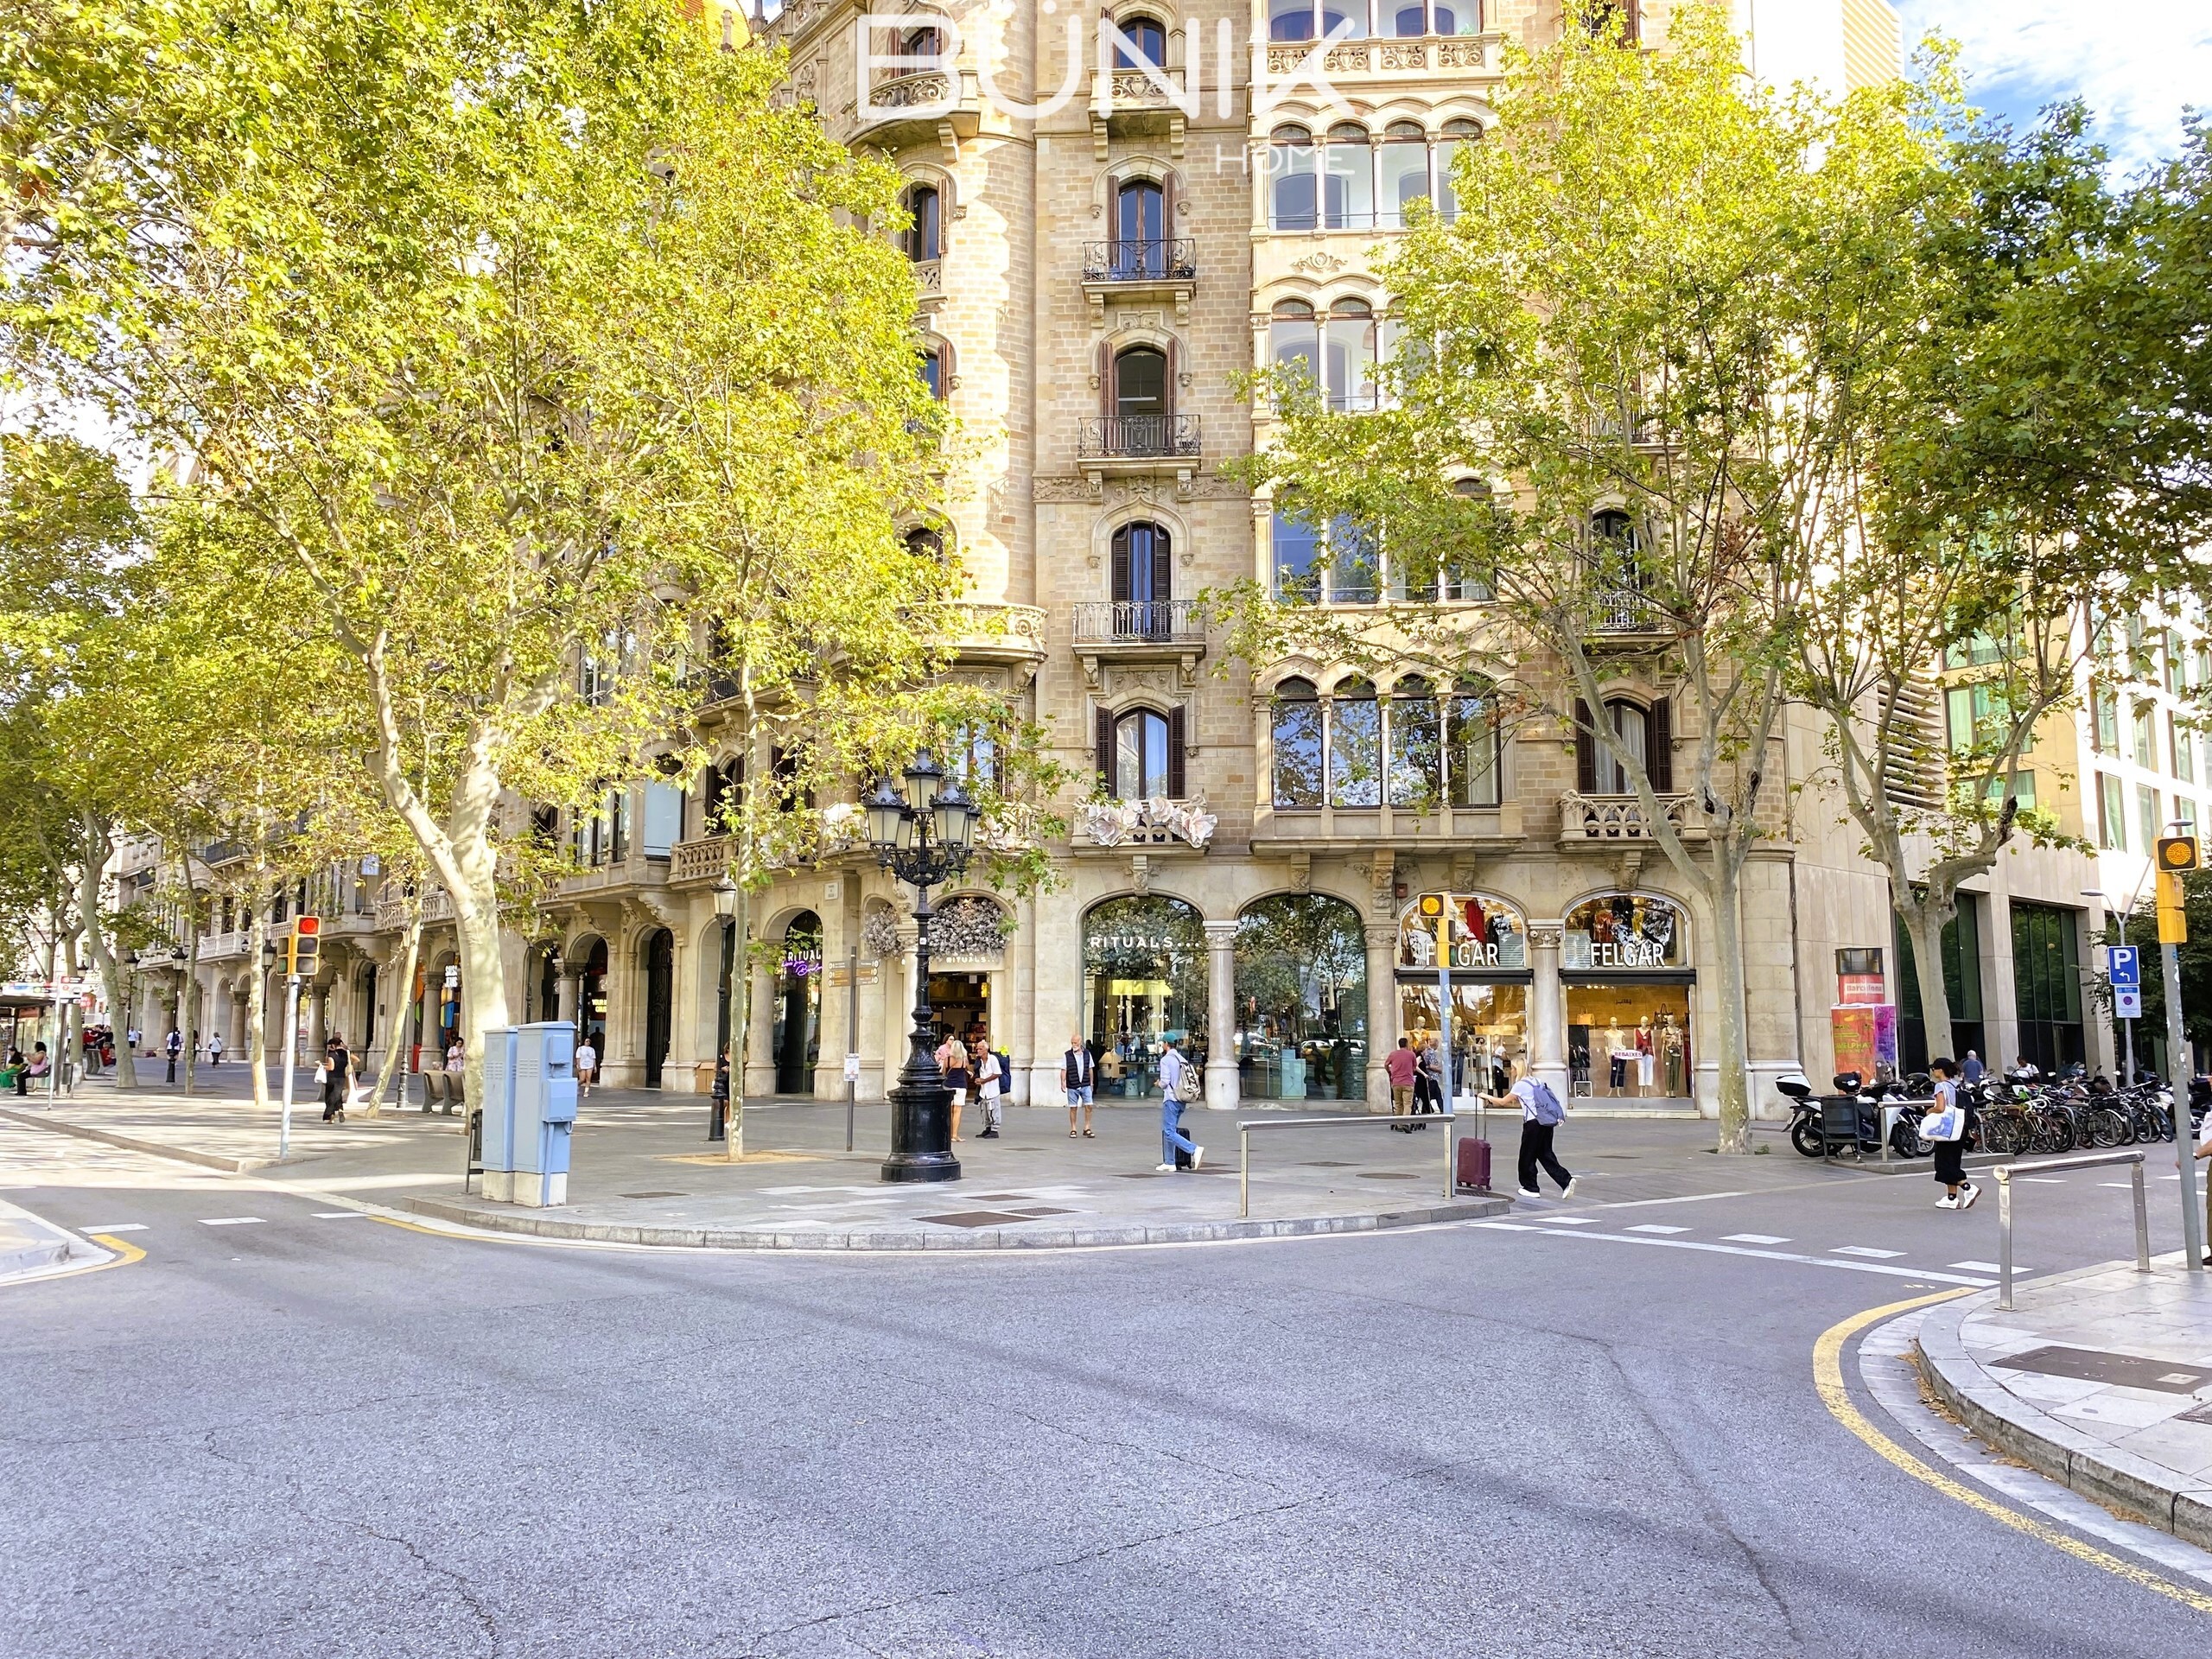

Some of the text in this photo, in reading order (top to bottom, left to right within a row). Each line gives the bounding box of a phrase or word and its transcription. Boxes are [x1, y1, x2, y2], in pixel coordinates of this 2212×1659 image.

[1426, 943, 1499, 967] FGAR
[1591, 943, 1665, 966] FELGAR
[2113, 949, 2133, 969] P
